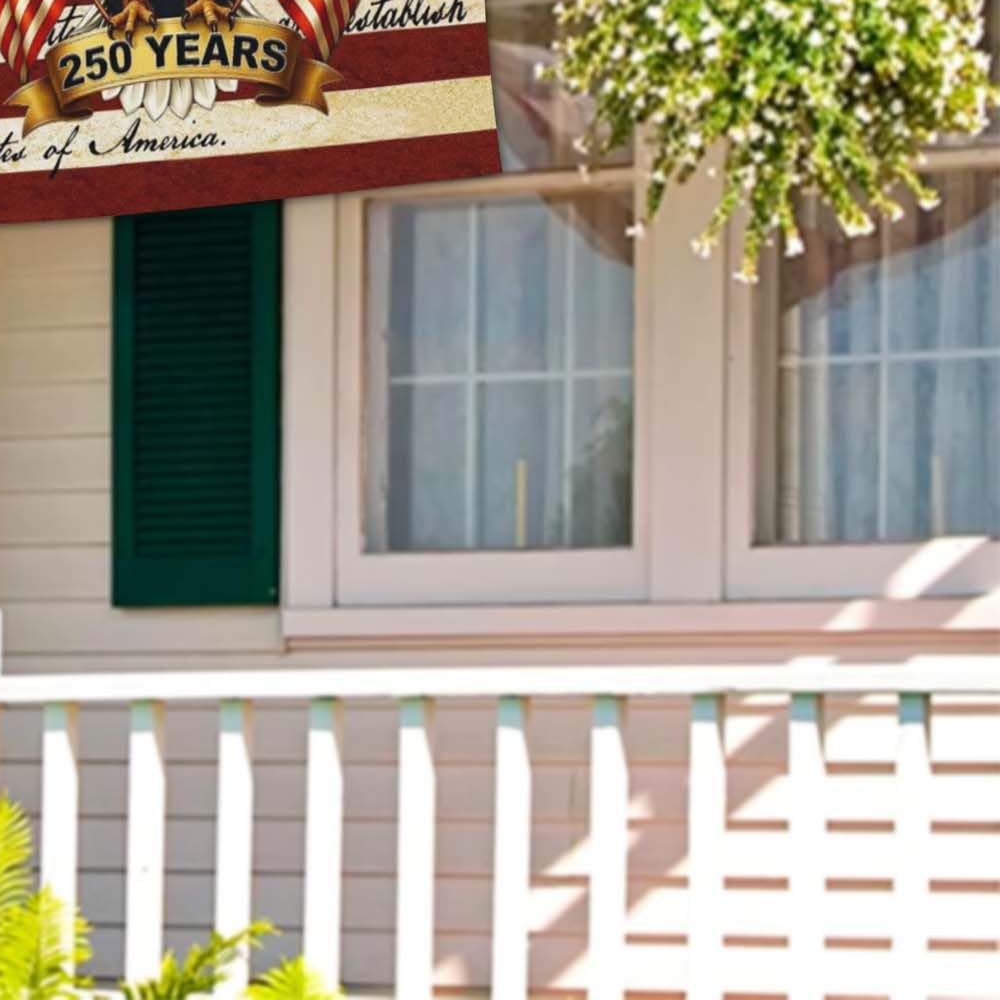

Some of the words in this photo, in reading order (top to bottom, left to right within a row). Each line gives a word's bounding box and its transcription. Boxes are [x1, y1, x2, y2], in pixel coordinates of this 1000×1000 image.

[58, 44, 132, 90] 250
[145, 33, 288, 73] YEARS
[43, 125, 81, 180] of
[88, 117, 228, 155] America.
